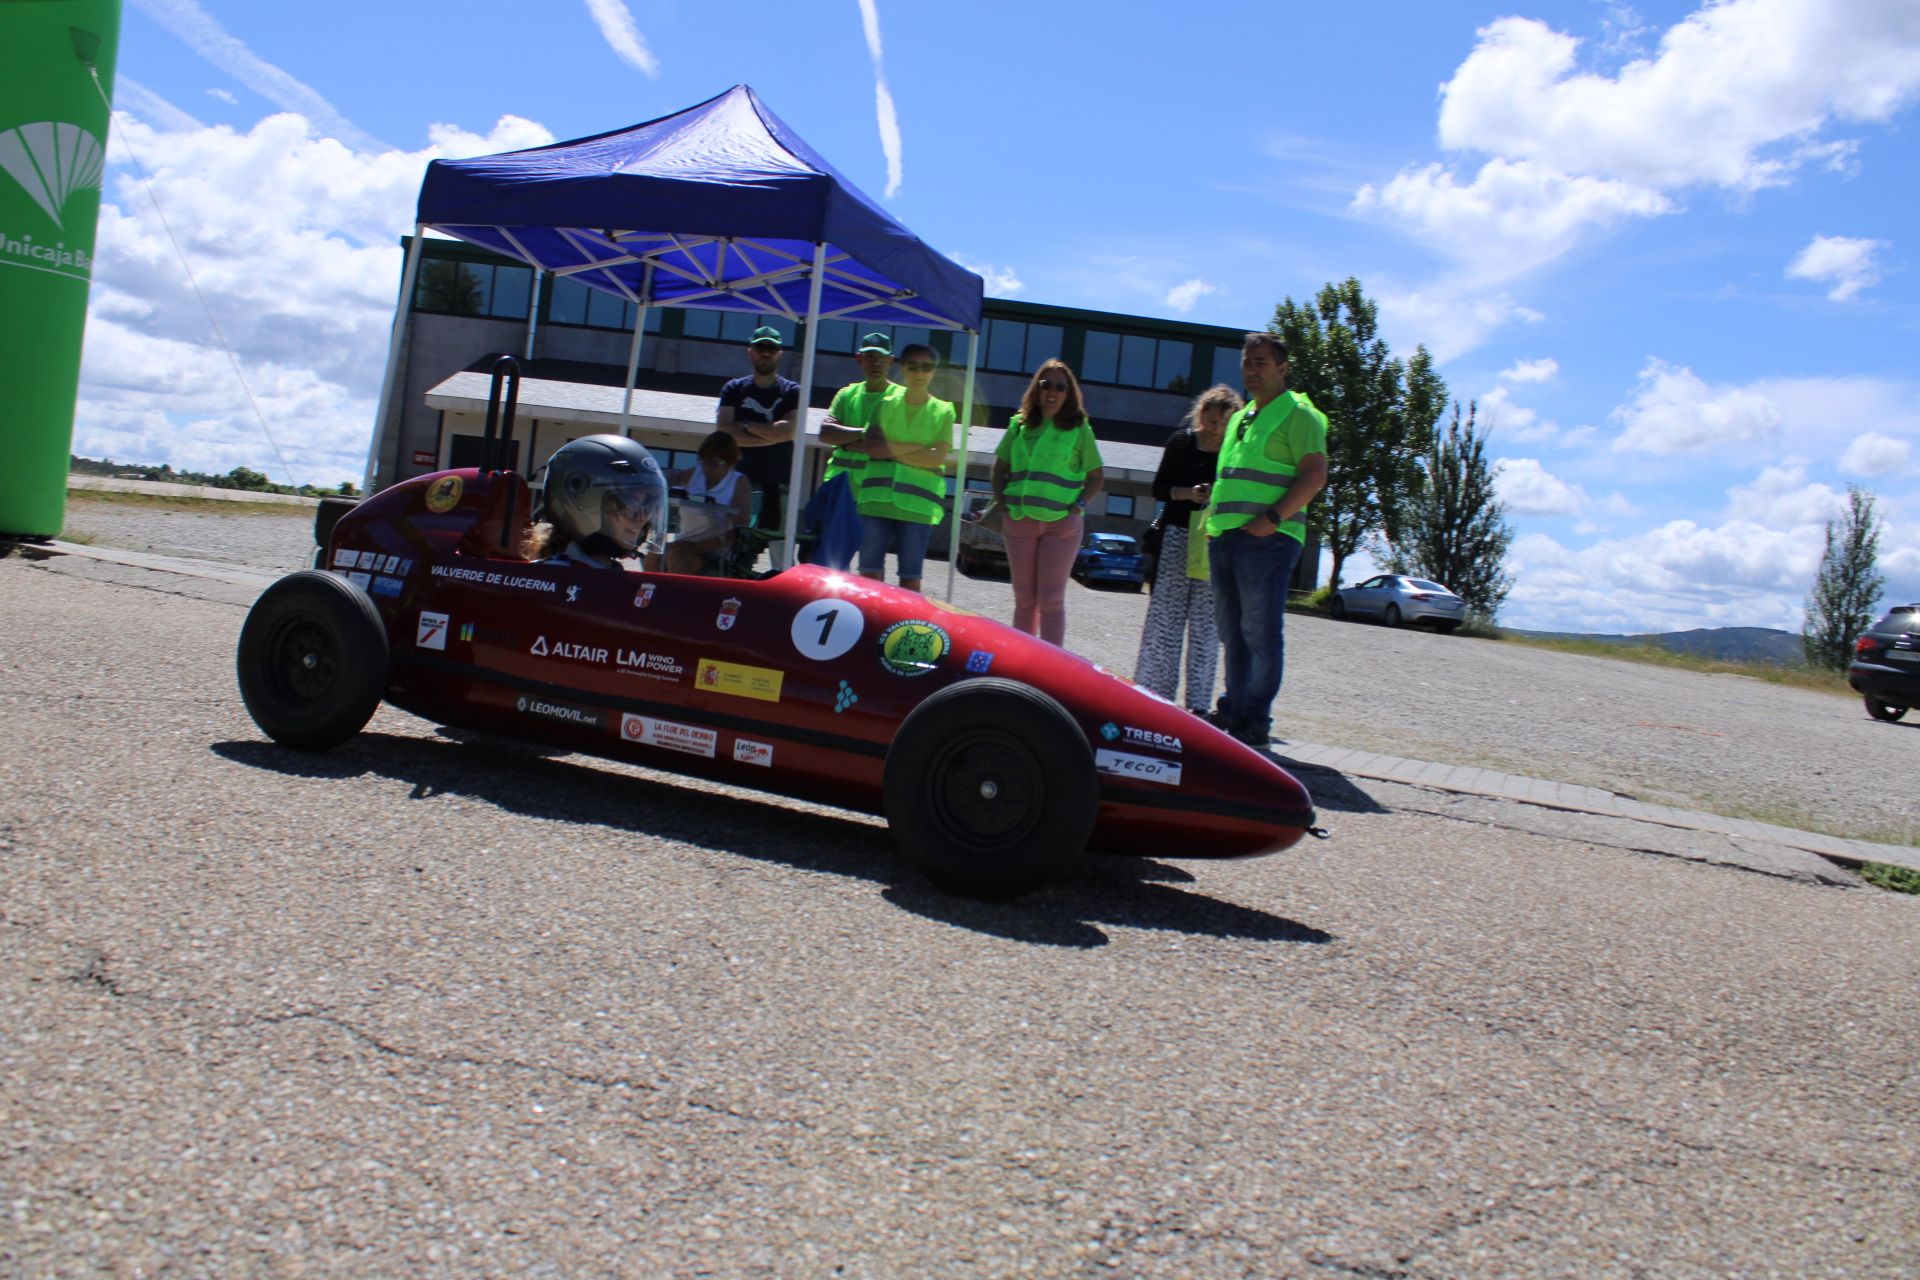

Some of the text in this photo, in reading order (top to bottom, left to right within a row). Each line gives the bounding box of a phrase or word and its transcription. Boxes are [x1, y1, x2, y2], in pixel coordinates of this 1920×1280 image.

[431, 565, 556, 592] VALVERDE DE LUCERNA
[815, 609, 839, 646] 1
[552, 641, 608, 664] ALTAIR
[616, 648, 674, 668] LM WIND
[646, 661, 684, 674] POWER
[1124, 726, 1182, 748] TRESCA
